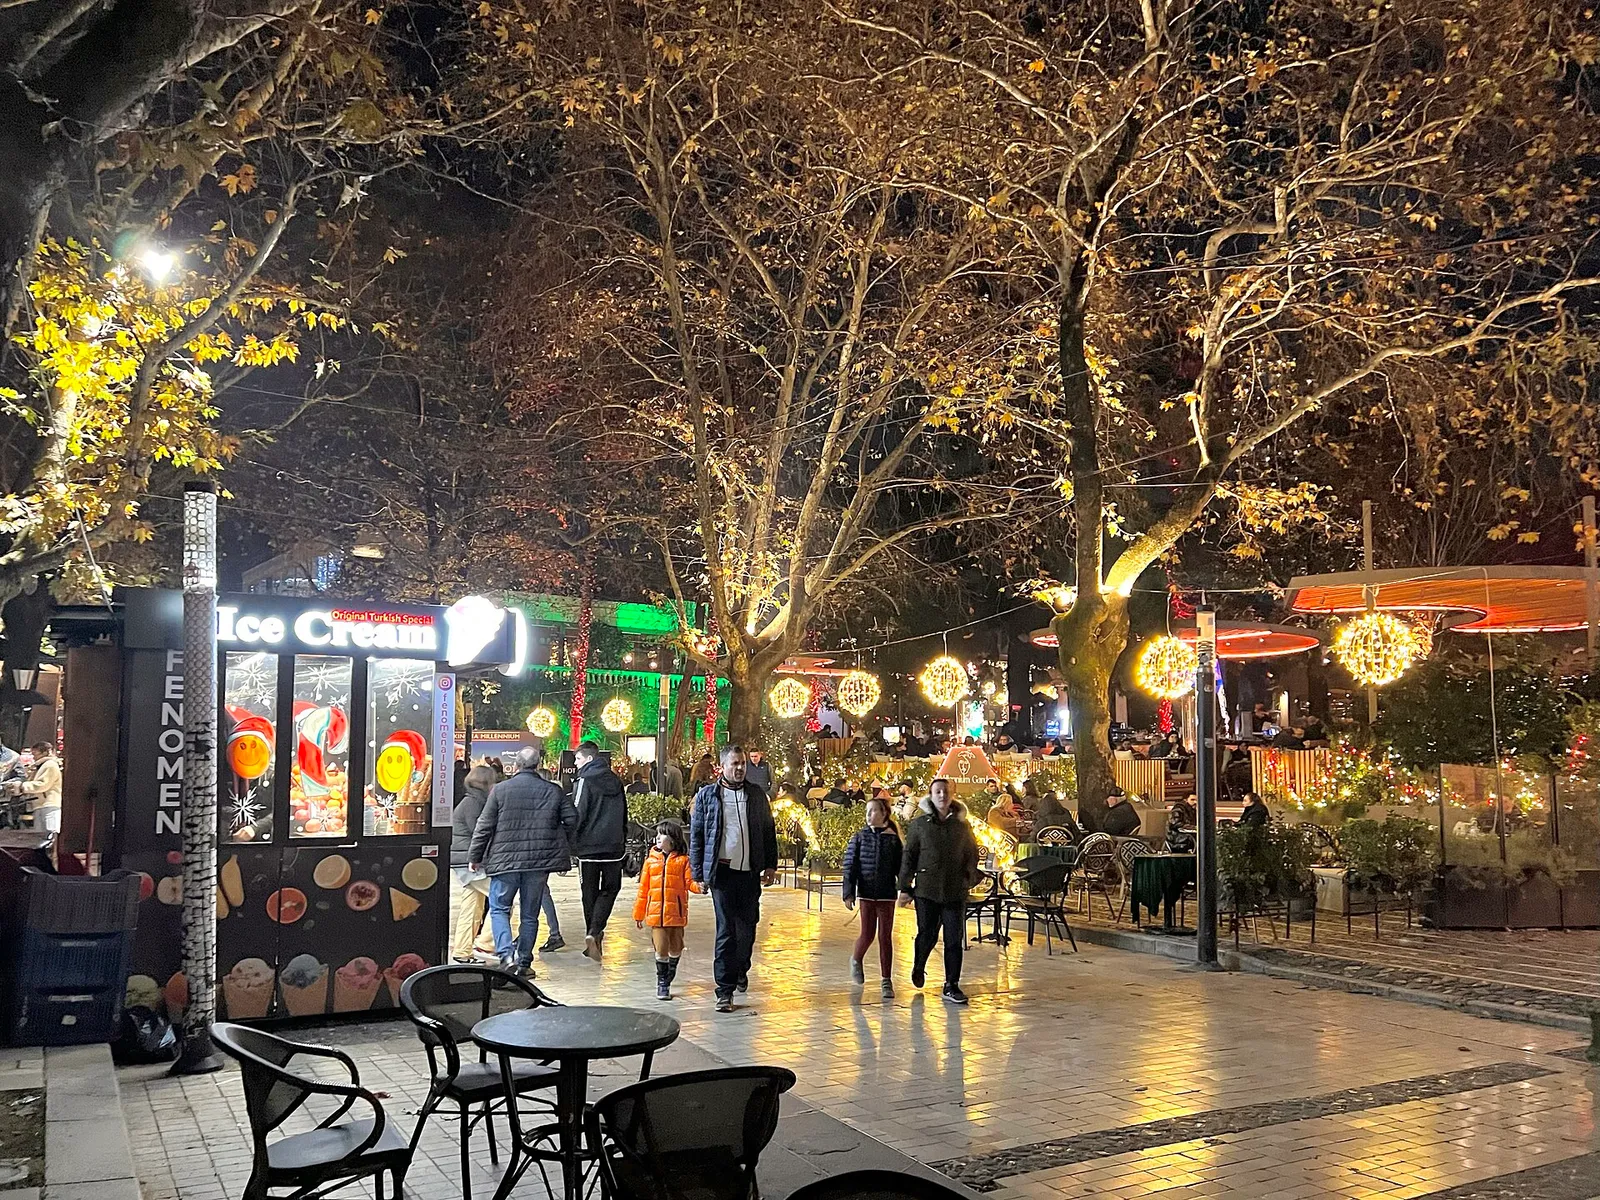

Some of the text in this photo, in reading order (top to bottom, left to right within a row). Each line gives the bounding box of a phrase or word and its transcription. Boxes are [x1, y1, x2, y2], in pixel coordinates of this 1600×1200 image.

[216, 606, 437, 650] Ice Cream
[331, 610, 434, 625] Original Turkish Special
[156, 650, 184, 834] FENOMEN
